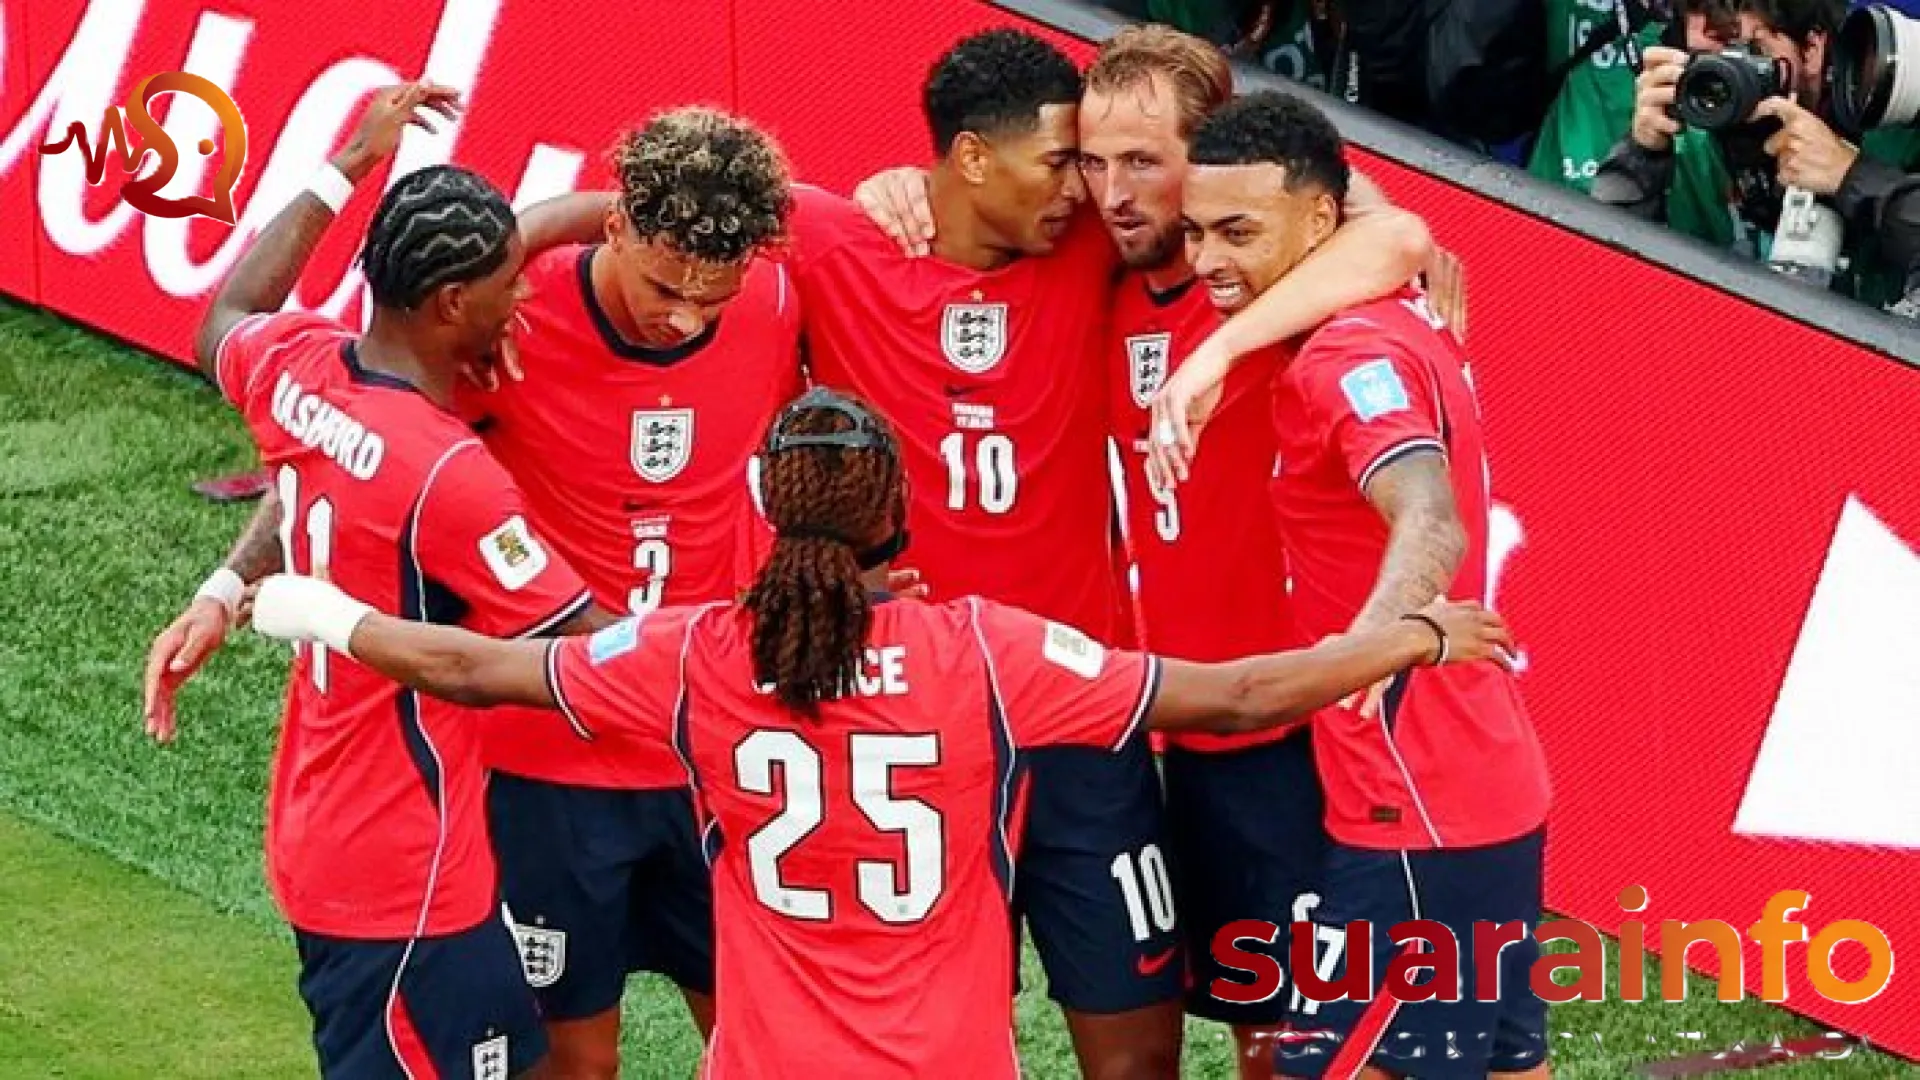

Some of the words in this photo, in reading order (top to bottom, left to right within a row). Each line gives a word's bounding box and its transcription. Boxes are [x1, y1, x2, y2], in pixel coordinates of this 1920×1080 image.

[940, 432, 1018, 514] 10
[627, 539, 670, 619] 3
[734, 729, 945, 923] 25
[1110, 843, 1176, 942] 10
